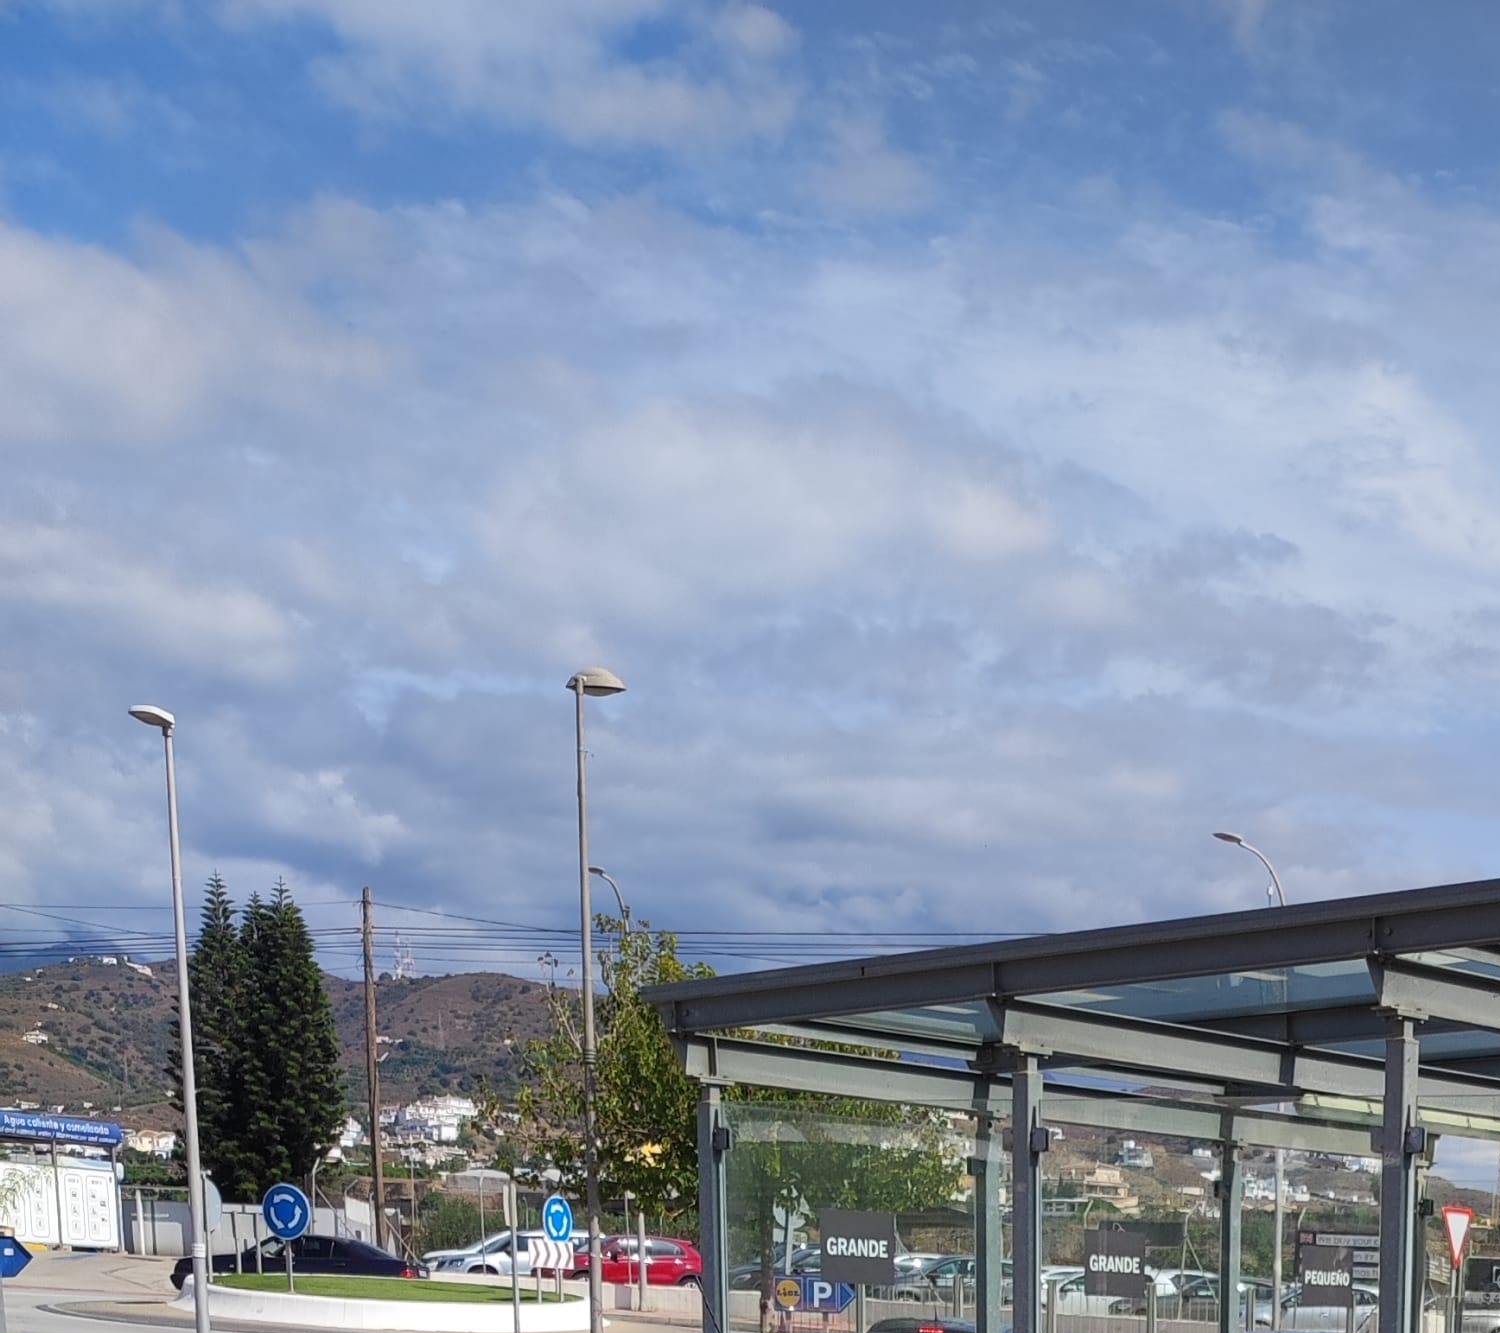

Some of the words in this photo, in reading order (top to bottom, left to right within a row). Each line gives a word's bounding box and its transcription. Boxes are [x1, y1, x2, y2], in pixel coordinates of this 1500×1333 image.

[826, 1236, 889, 1258] GRANDE
[1089, 1254, 1141, 1274] GRANDE
[1304, 1270, 1350, 1287] PEQUEÑO
[813, 1282, 833, 1308] P
